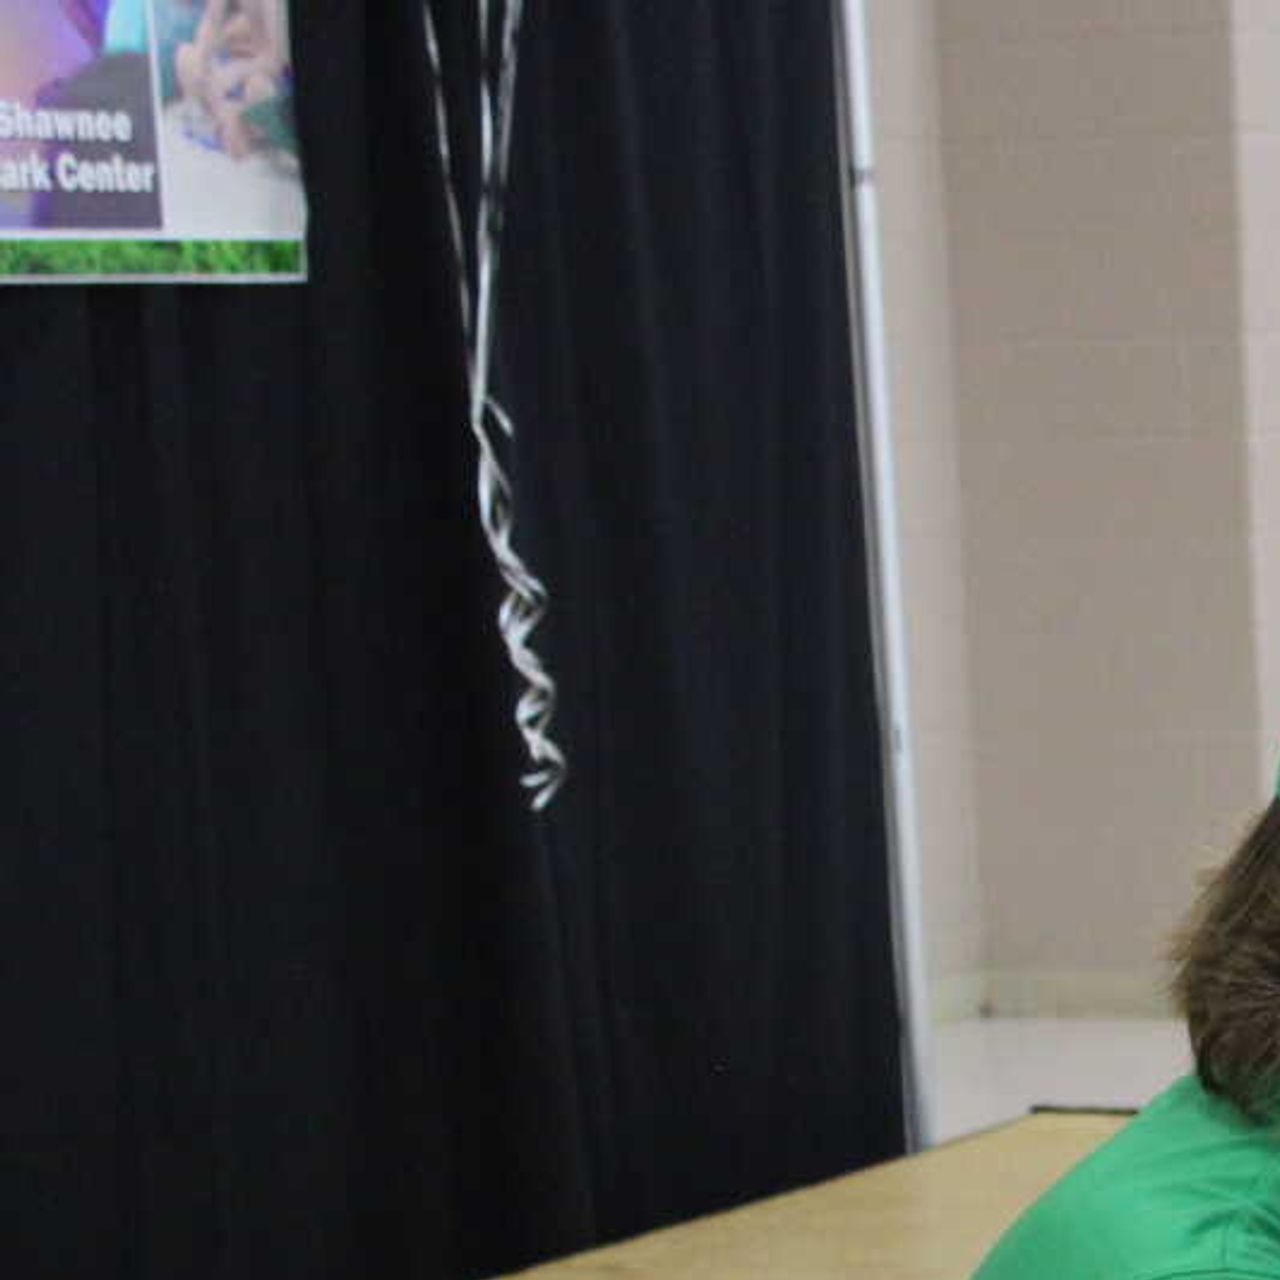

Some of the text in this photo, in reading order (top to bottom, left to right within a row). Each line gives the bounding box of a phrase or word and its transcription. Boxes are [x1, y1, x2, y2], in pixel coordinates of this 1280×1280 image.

[0, 99, 132, 142] Shawnee
[0, 152, 155, 192] ark Center
